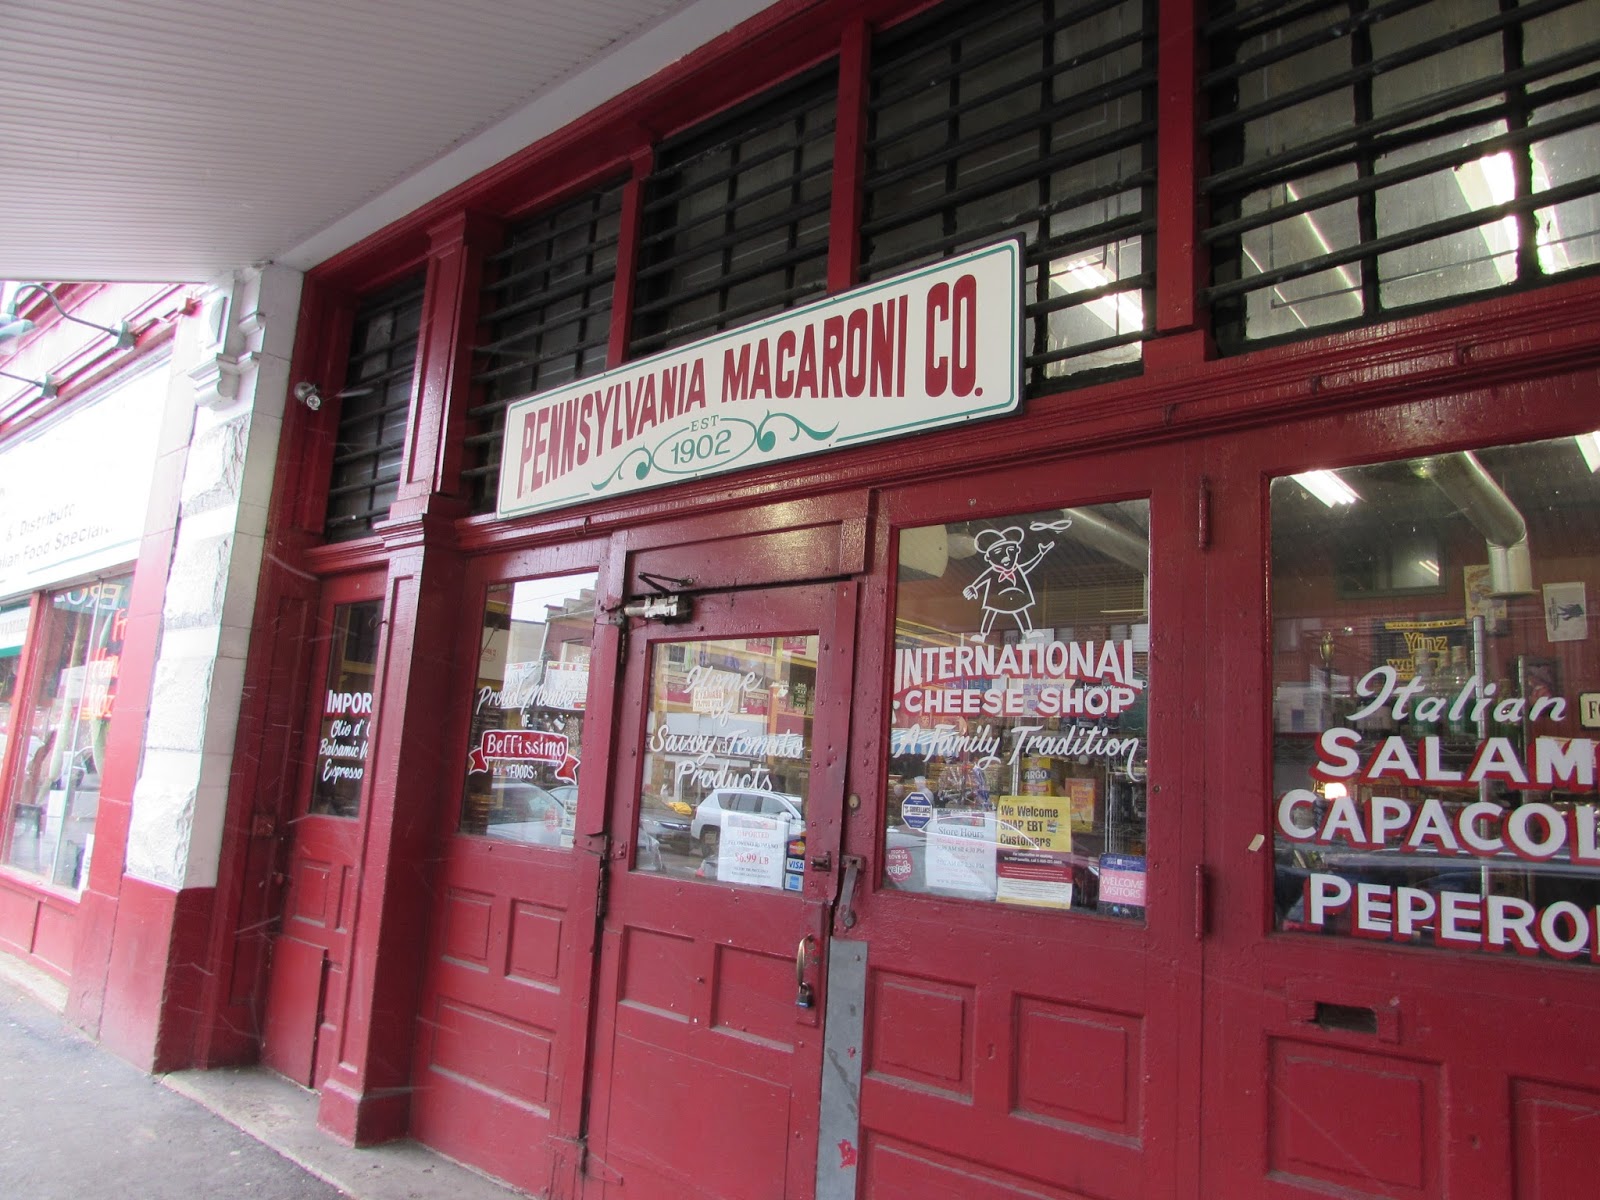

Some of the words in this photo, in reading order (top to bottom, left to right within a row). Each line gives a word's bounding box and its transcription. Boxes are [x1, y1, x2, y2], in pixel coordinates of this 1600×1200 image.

[517, 356, 706, 499] PENNSYLVANIA
[721, 294, 909, 403] MACARONI
[924, 273, 984, 398] CO.
[690, 413, 720, 433] EST
[670, 429, 732, 465] 1902
[24, 542, 50, 560] Food
[1403, 632, 1448, 652] Yinz
[893, 639, 1143, 695] INTERNATIONAL
[683, 665, 763, 693] Home
[475, 677, 521, 715] Proud
[520, 684, 580, 715] Member
[904, 688, 1024, 714] CHEESE
[1036, 688, 1136, 715] SHOP
[1345, 665, 1567, 722] Italian
[710, 696, 735, 727] of
[330, 719, 352, 738] Olio
[320, 738, 360, 758] Balsamic
[486, 734, 565, 757] Bellissimo
[650, 724, 718, 766] Savoy
[724, 728, 806, 759] Tomato
[892, 723, 921, 759] A
[923, 725, 1002, 770] Family
[1007, 725, 1142, 783] Tradition
[1313, 727, 1595, 786] SALAM
[322, 758, 364, 785] Espresso
[510, 764, 535, 779] FOODS
[676, 760, 773, 792] Products
[1024, 769, 1047, 780] ARGO
[1001, 805, 1014, 816] We
[1017, 806, 1059, 818] Welcome
[938, 827, 958, 837] Store
[961, 828, 985, 838] Hours
[1000, 819, 1024, 831] SNAP
[1027, 821, 1044, 832] EBT
[1276, 788, 1600, 860] CAPACOL
[1000, 834, 1051, 848] Customers
[735, 852, 757, 863] $6.99
[789, 861, 804, 870] VISA
[1101, 876, 1145, 890] WELCOME
[1103, 885, 1141, 899] VISITORS
[1309, 873, 1600, 953] PEPERO
